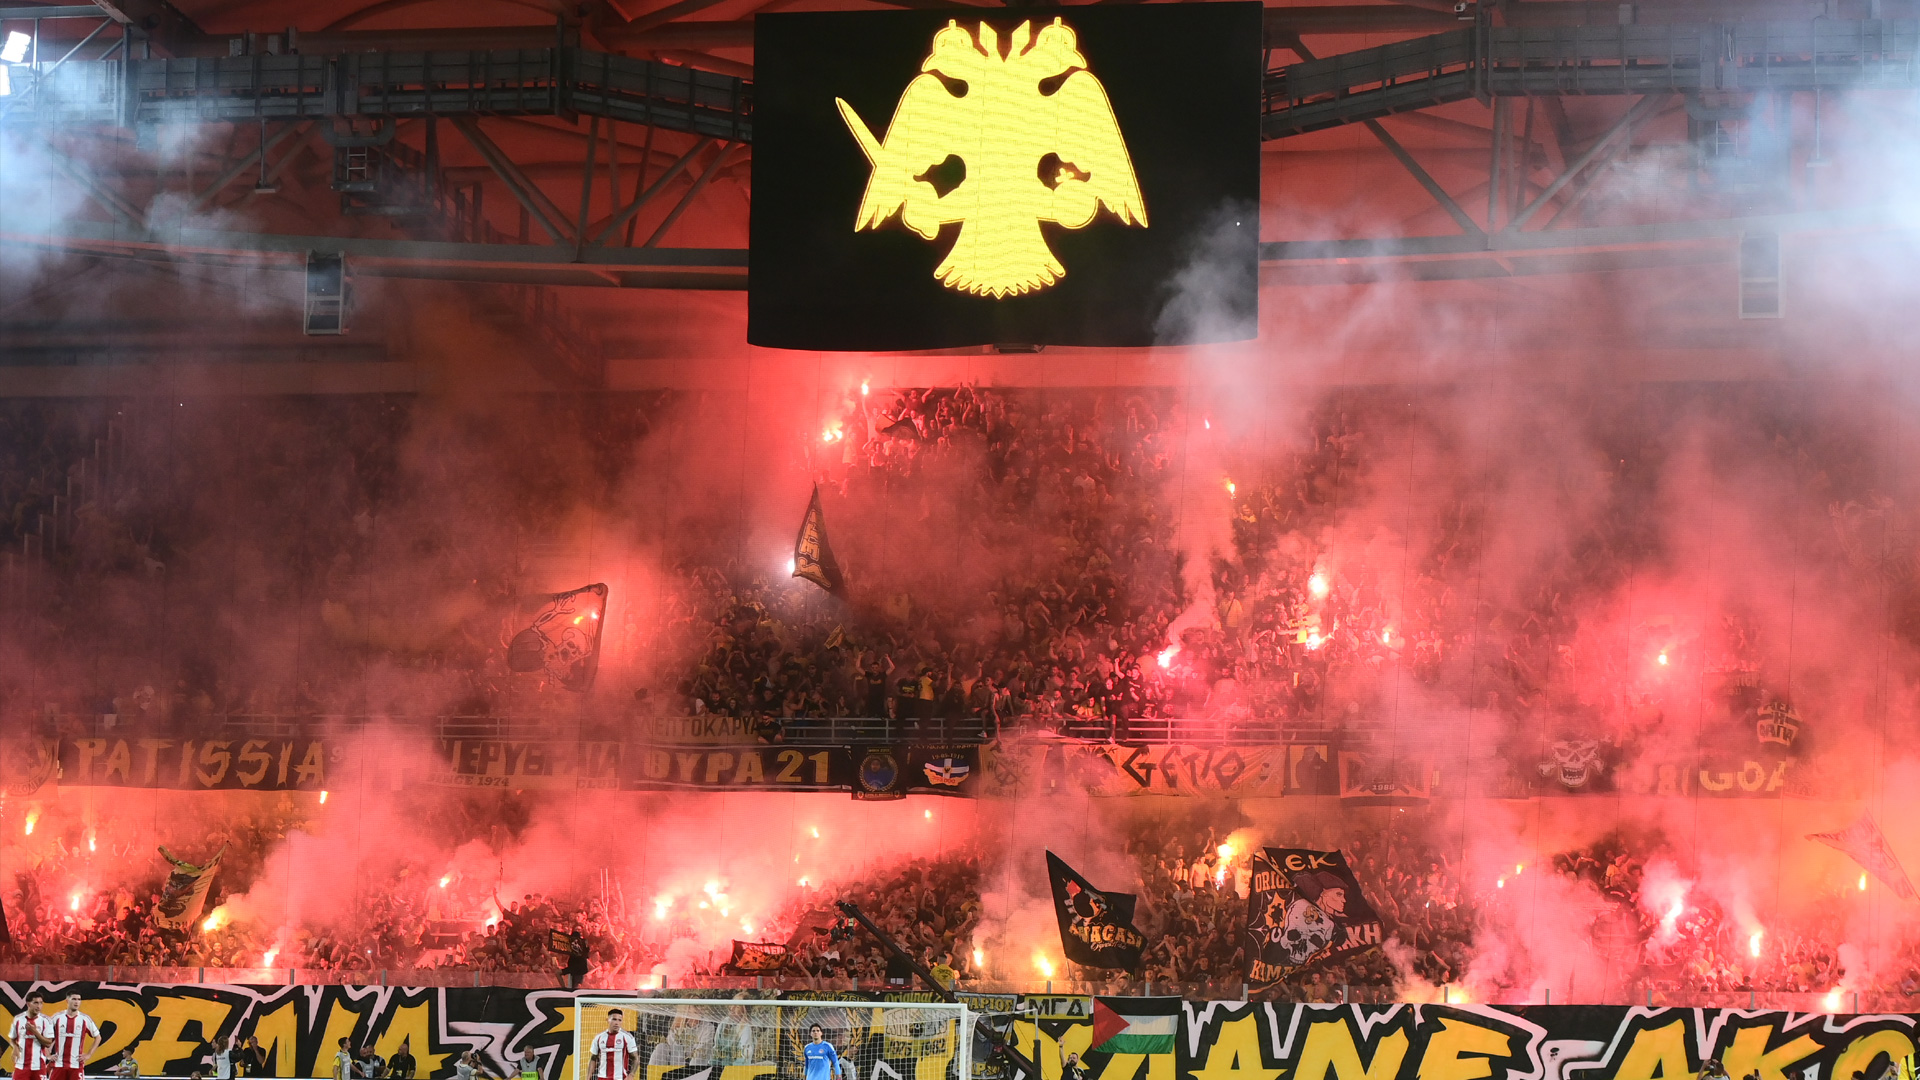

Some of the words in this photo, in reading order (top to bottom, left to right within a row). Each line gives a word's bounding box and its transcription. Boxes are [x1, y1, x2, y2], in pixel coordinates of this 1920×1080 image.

[72, 738, 325, 788] PATISSIA
[775, 749, 830, 783] 21
[477, 776, 510, 787] 1974
